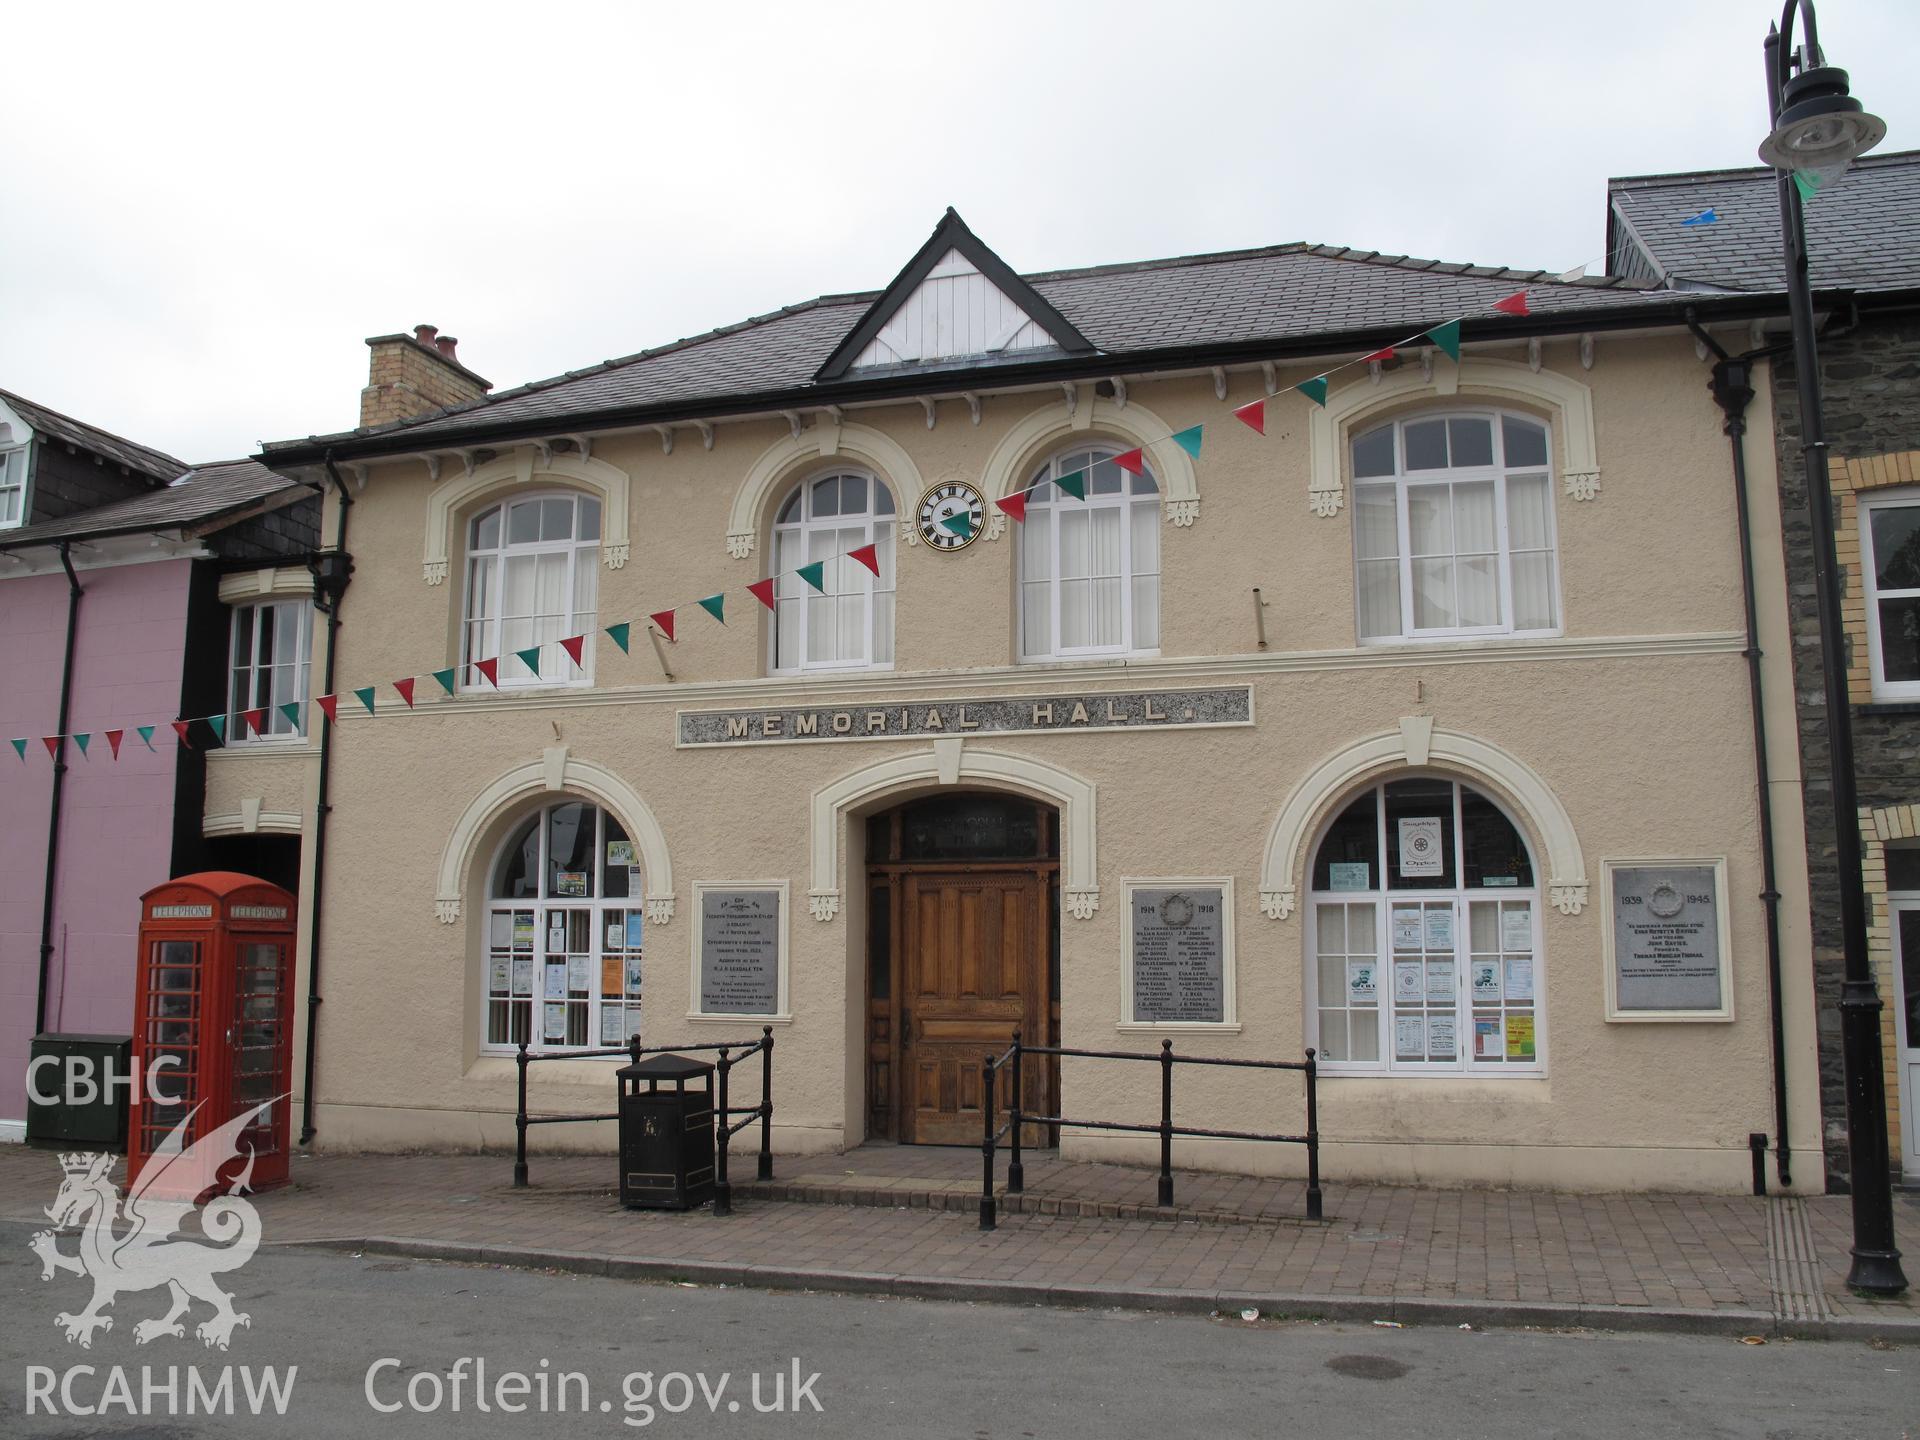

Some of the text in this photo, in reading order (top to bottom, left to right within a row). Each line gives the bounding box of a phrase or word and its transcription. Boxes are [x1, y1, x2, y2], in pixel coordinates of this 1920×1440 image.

[728, 699, 1195, 737] MEMORIAL HALL.
[155, 906, 209, 917] TELEPHONE
[234, 907, 286, 918] TELEPHONE
[1140, 906, 1155, 914] 1914
